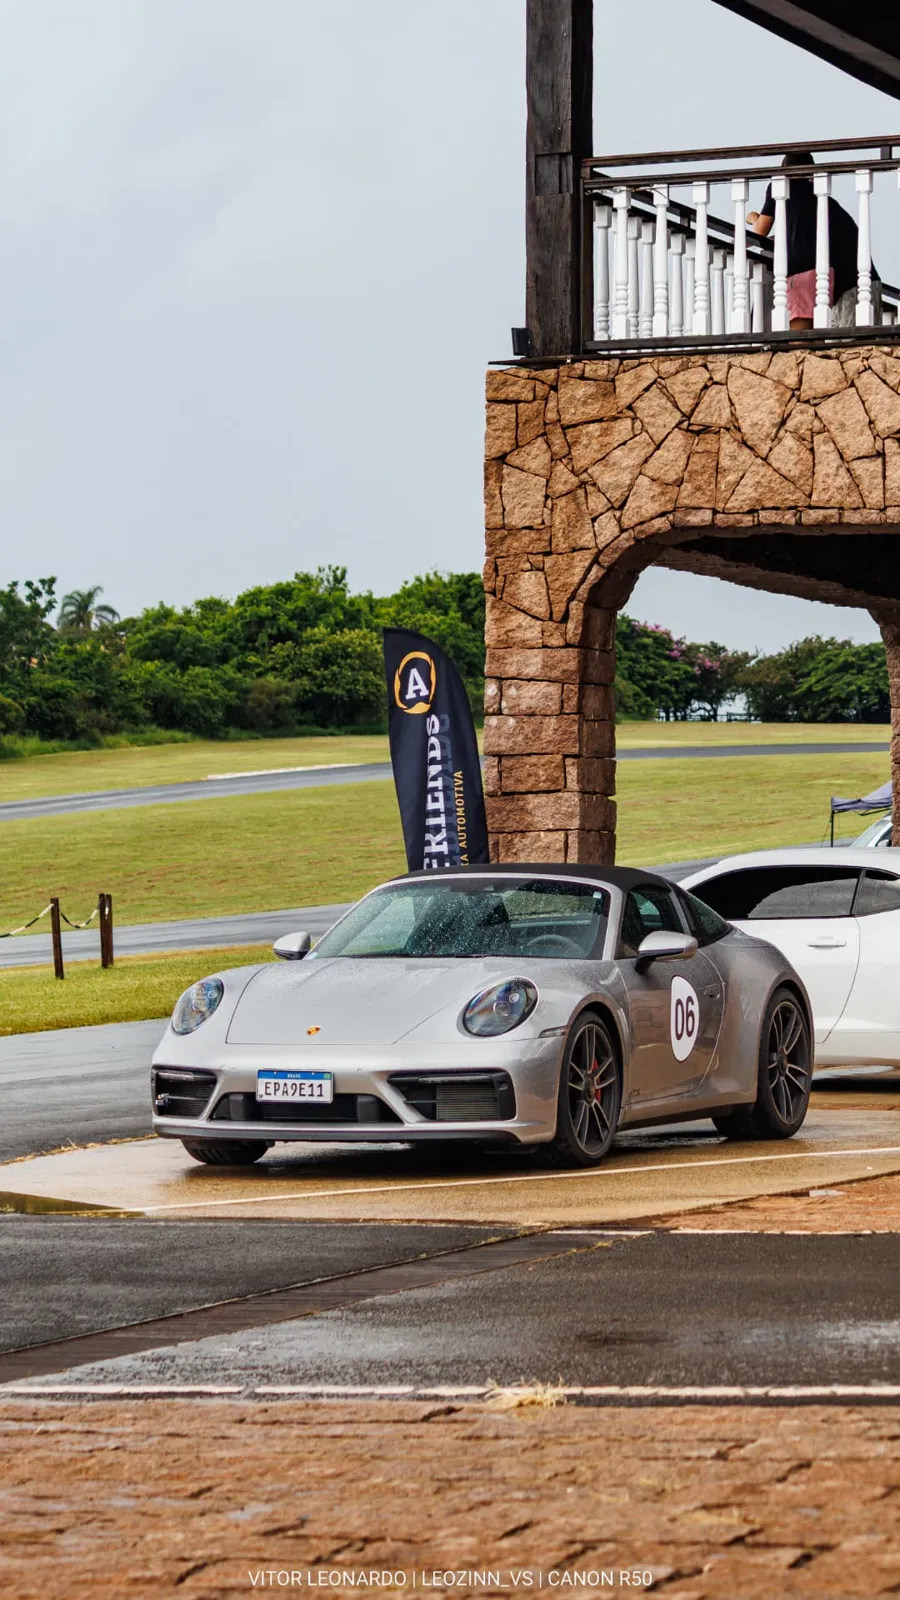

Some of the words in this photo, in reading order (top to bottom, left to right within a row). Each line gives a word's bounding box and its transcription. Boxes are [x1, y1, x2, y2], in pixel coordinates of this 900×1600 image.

[405, 667, 430, 700] A
[453, 770, 468, 849] AUTOMOTIVA
[675, 995, 695, 1041] 06
[264, 1081, 324, 1098] EPA9E11
